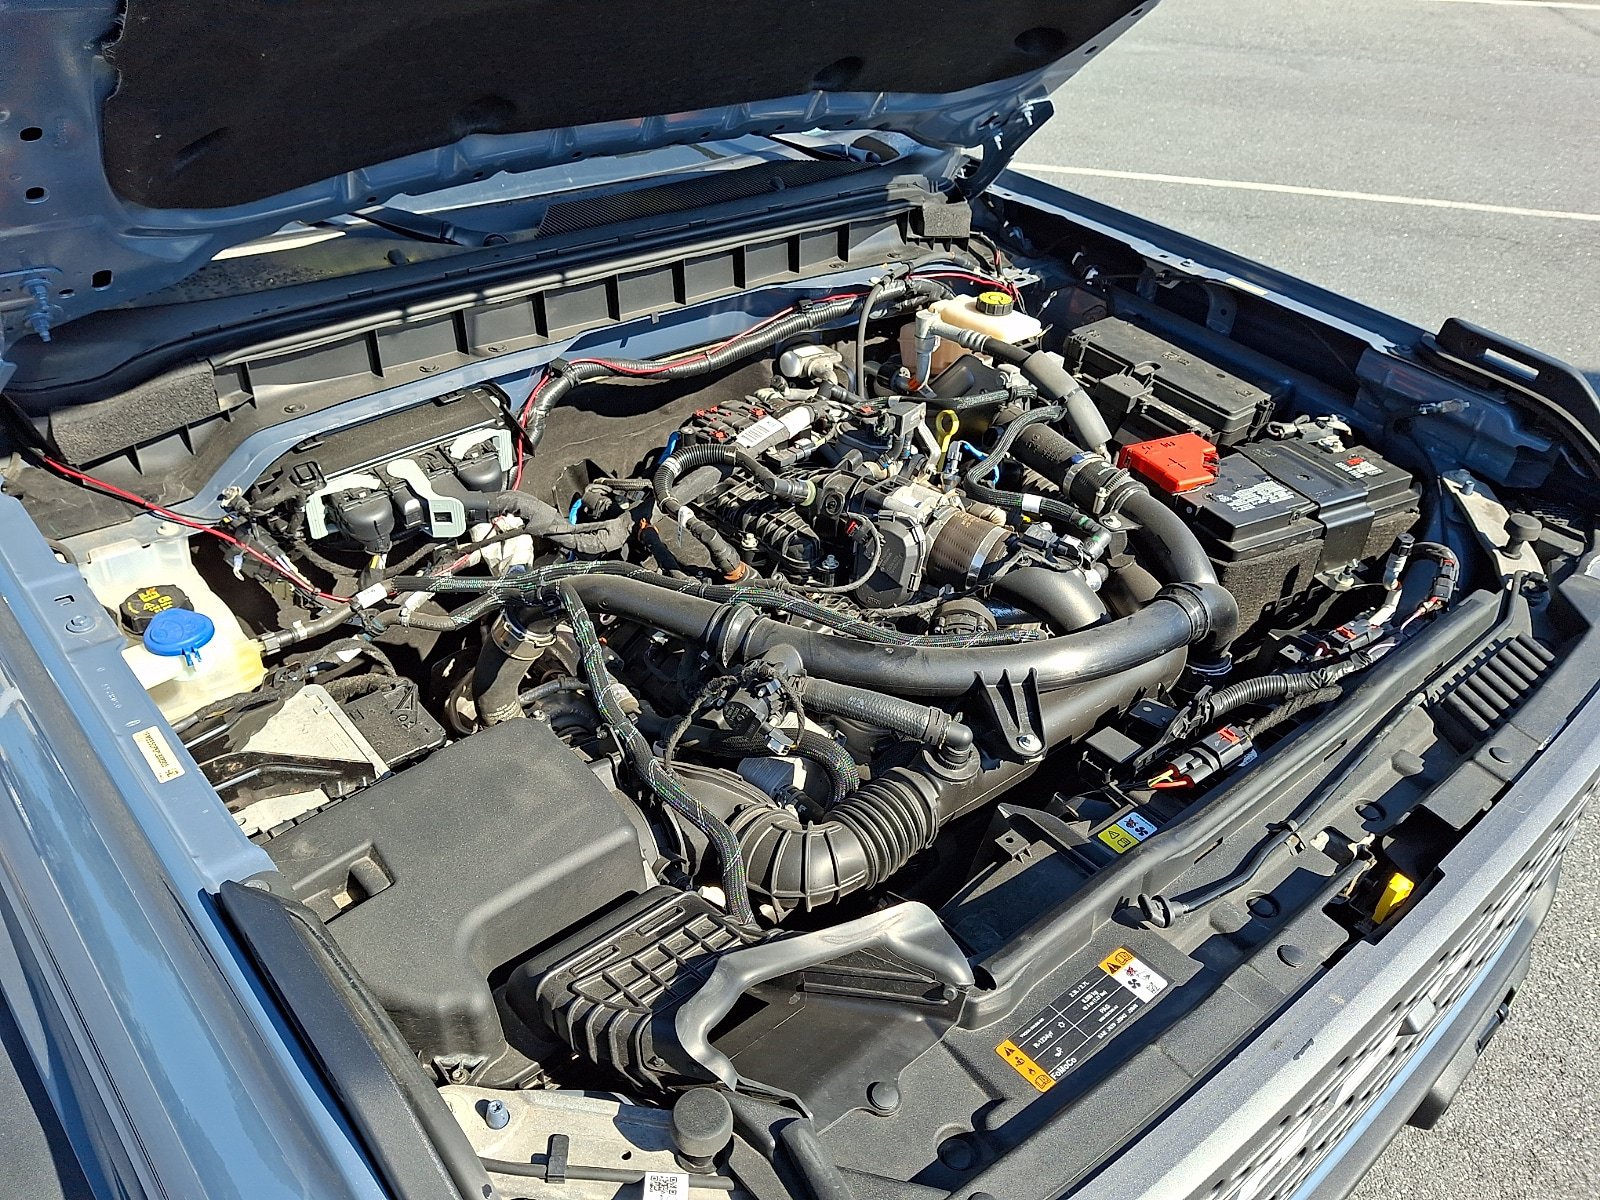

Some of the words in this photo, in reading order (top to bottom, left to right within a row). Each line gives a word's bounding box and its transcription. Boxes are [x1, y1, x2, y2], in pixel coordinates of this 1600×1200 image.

[1098, 1003, 1111, 1014] PAG
[1032, 1030, 1054, 1049] R-1234yf
[1097, 1030, 1108, 1039] SAE
[1050, 1057, 1077, 1080] FoMoCo
